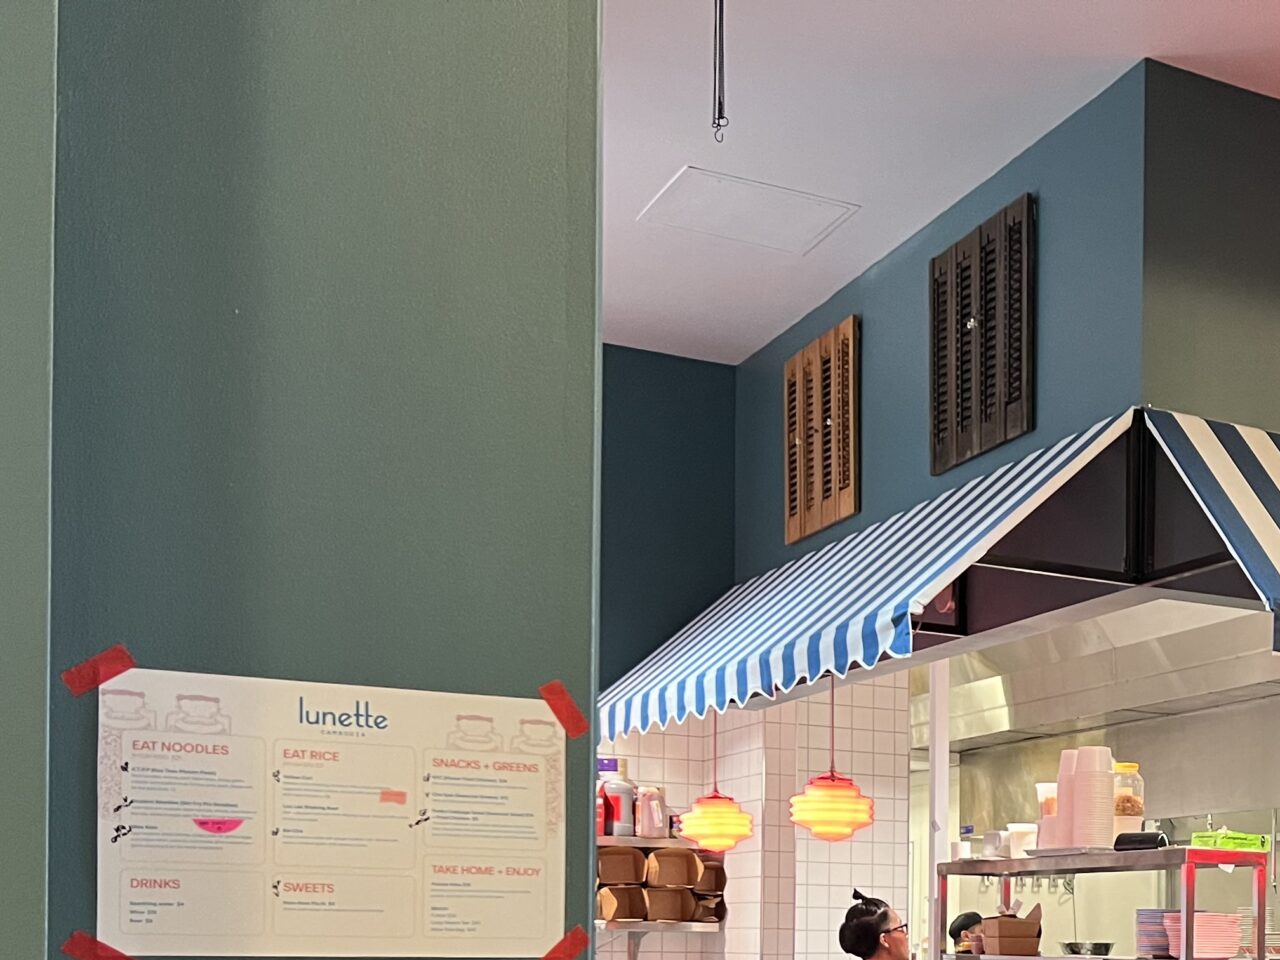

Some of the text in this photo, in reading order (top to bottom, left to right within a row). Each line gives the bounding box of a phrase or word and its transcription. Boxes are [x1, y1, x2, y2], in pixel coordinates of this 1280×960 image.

[299, 696, 389, 729] lunette
[132, 739, 230, 755] EAT NOODLES
[283, 749, 340, 762] EAT RICE
[432, 757, 481, 770] SNACKS
[492, 761, 539, 773] GREENS
[431, 864, 459, 875] TAKE
[461, 866, 495, 876] HOME
[505, 867, 542, 878] ENJOY
[130, 878, 181, 890] DRINKS
[283, 882, 335, 894] SWEETS
